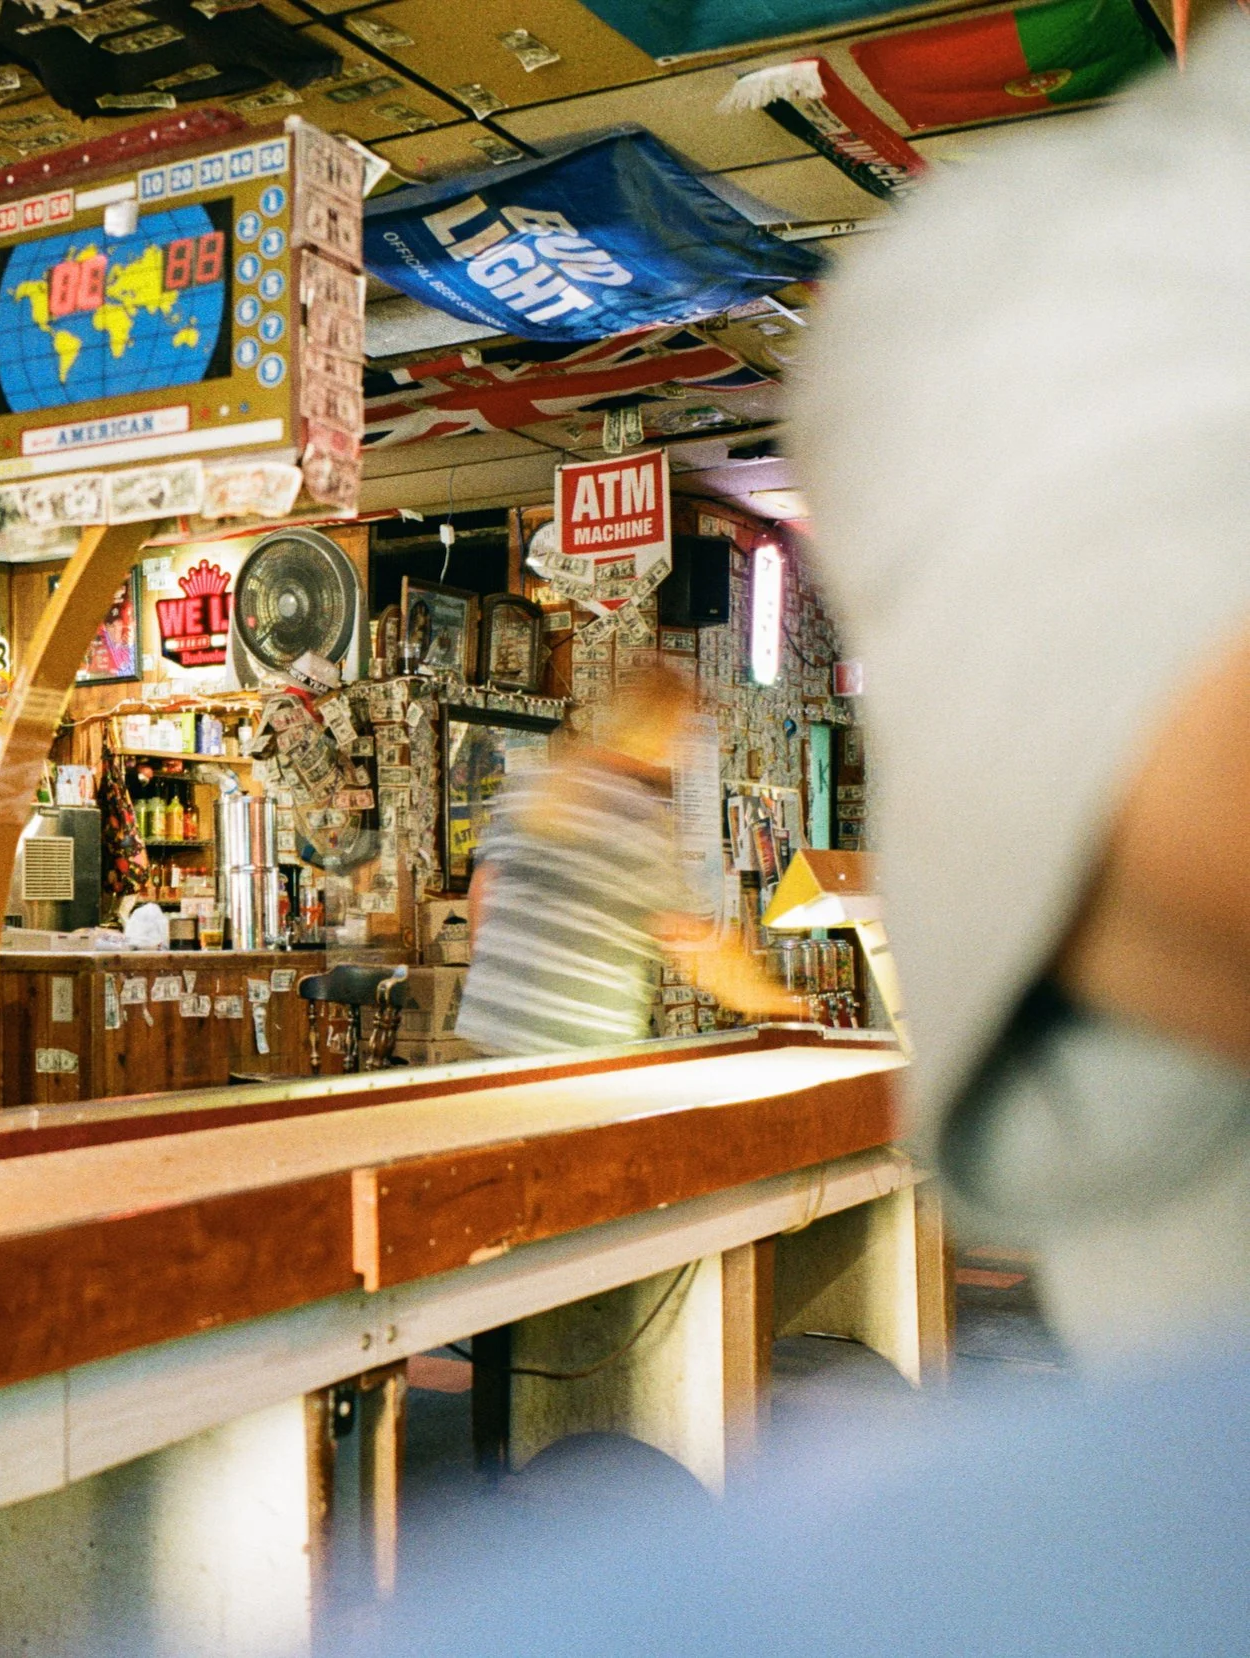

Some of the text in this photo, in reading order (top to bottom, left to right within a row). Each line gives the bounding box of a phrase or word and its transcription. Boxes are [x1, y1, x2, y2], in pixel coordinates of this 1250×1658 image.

[143, 146, 284, 196] 10 20 30 40 50
[0, 209, 17, 231] 30
[24, 203, 43, 225] 40
[50, 197, 70, 218] 50
[166, 232, 224, 288] 88
[383, 231, 434, 281] OFFICIAL
[422, 194, 594, 323] LIGHT
[500, 206, 633, 286] BUD
[58, 417, 154, 445] AMERICAN
[571, 463, 656, 522] ATM
[574, 517, 653, 546] MACHINE
[158, 601, 203, 637] WE
